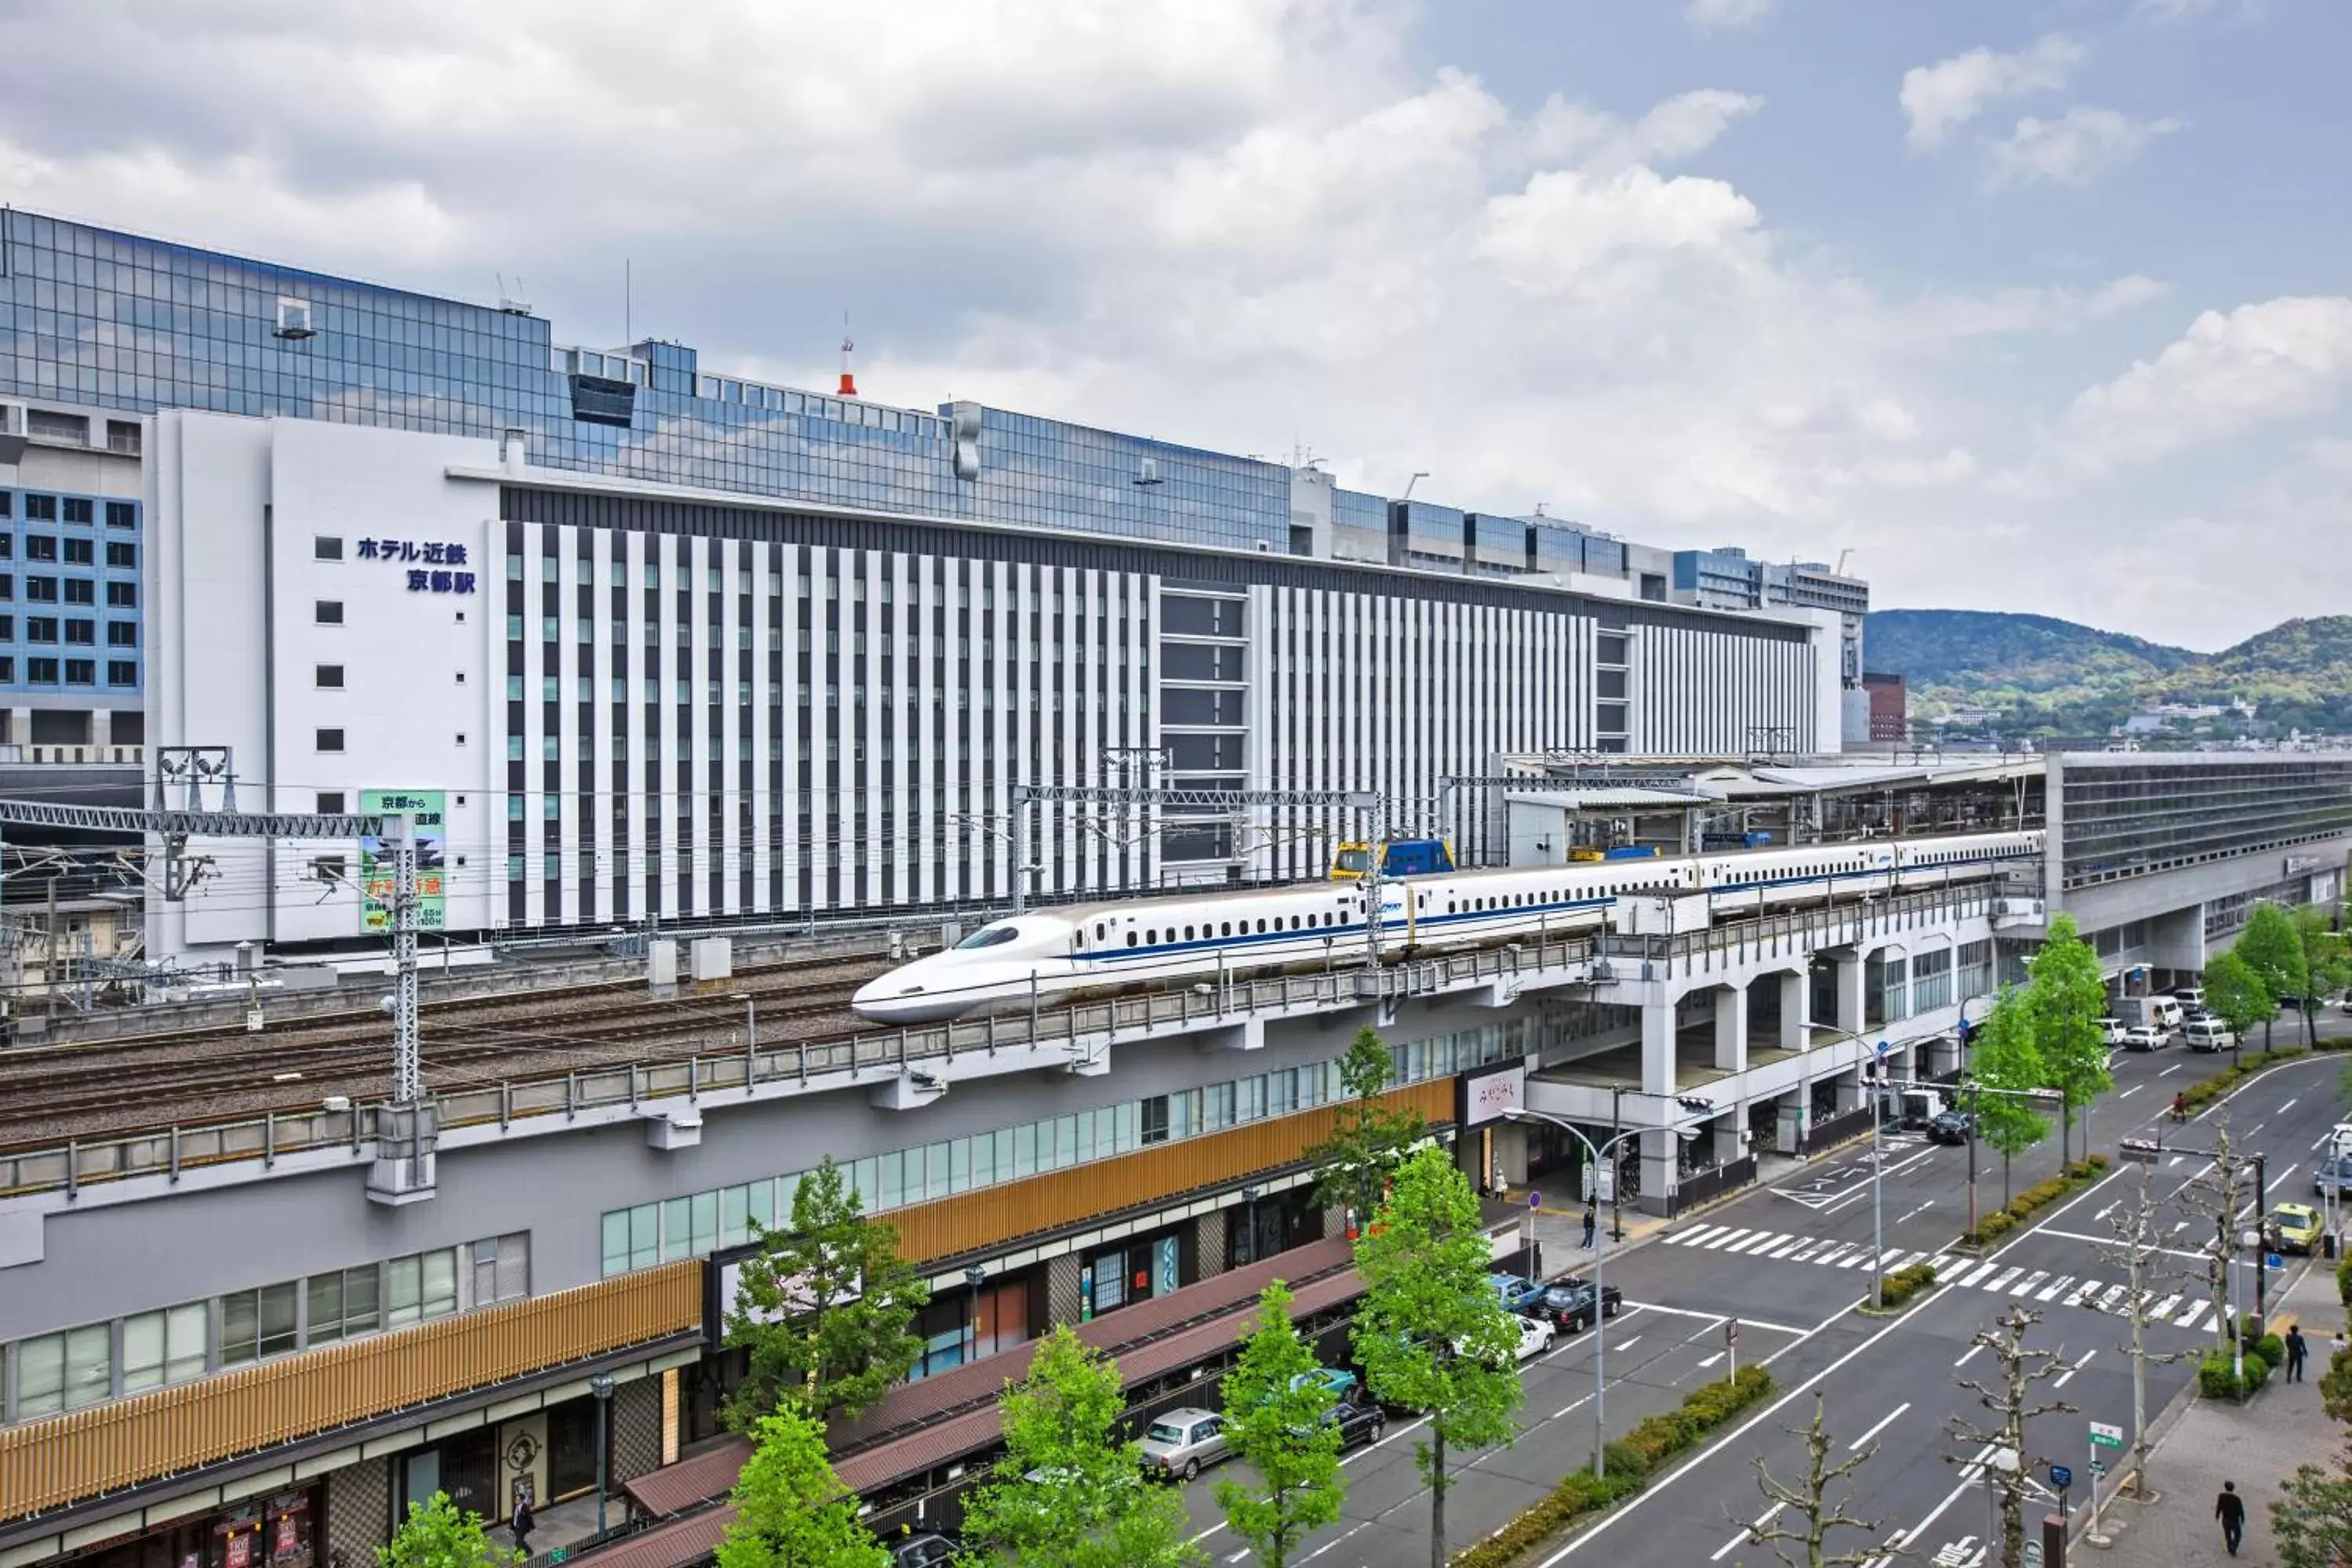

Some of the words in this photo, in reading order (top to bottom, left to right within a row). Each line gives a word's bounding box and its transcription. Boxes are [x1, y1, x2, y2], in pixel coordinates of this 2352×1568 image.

[358, 538, 467, 565] ホテル近鉄
[406, 568, 476, 593] 京都駅
[381, 796, 426, 809] 京都から
